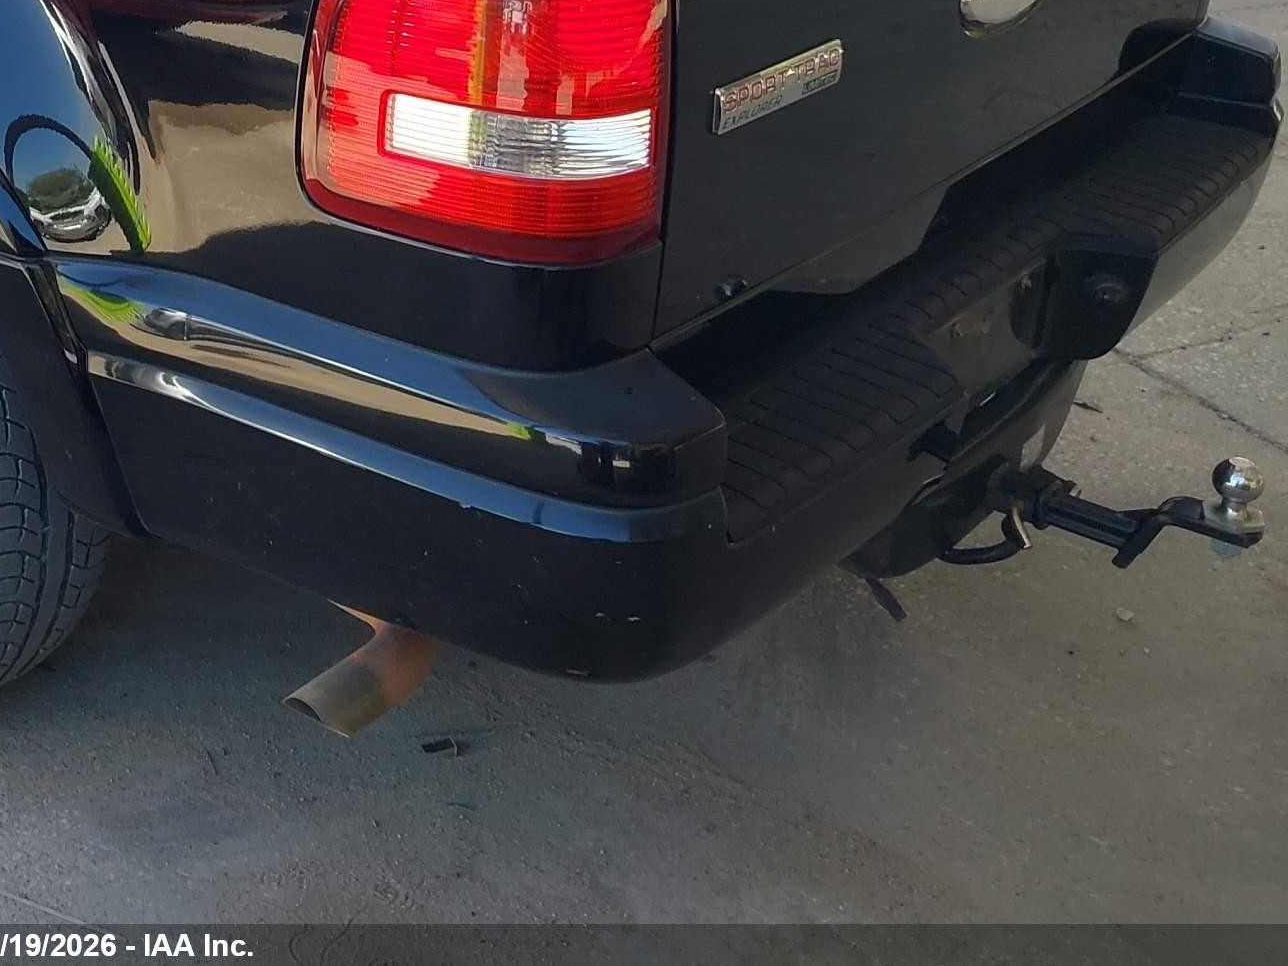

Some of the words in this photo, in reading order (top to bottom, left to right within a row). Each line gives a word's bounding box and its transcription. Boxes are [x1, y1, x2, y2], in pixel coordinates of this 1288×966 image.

[723, 70, 789, 113] SPORT
[793, 47, 841, 80] TRAC
[721, 94, 783, 130] EXPLORER
